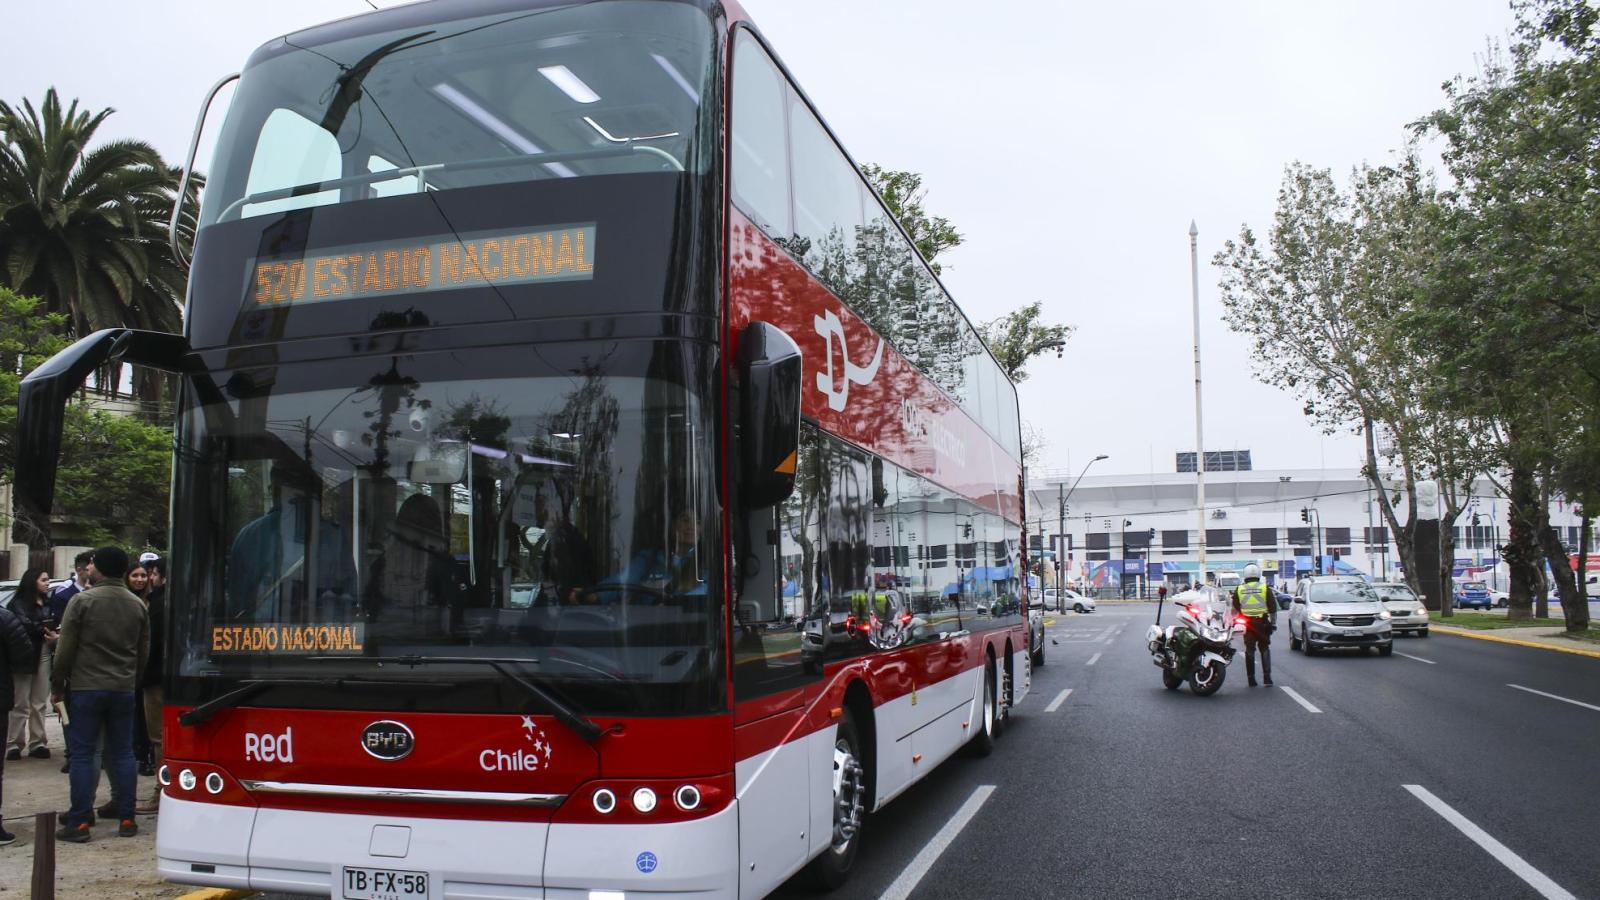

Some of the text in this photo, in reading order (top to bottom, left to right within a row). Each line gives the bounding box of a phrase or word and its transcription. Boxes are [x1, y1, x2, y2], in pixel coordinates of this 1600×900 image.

[256, 230, 594, 304] 520 ESTADIO NACIONAL
[213, 626, 363, 651] ESTADIO NACIONAL
[245, 726, 293, 763] Red
[367, 732, 408, 749] BYD
[479, 748, 539, 771] Chile
